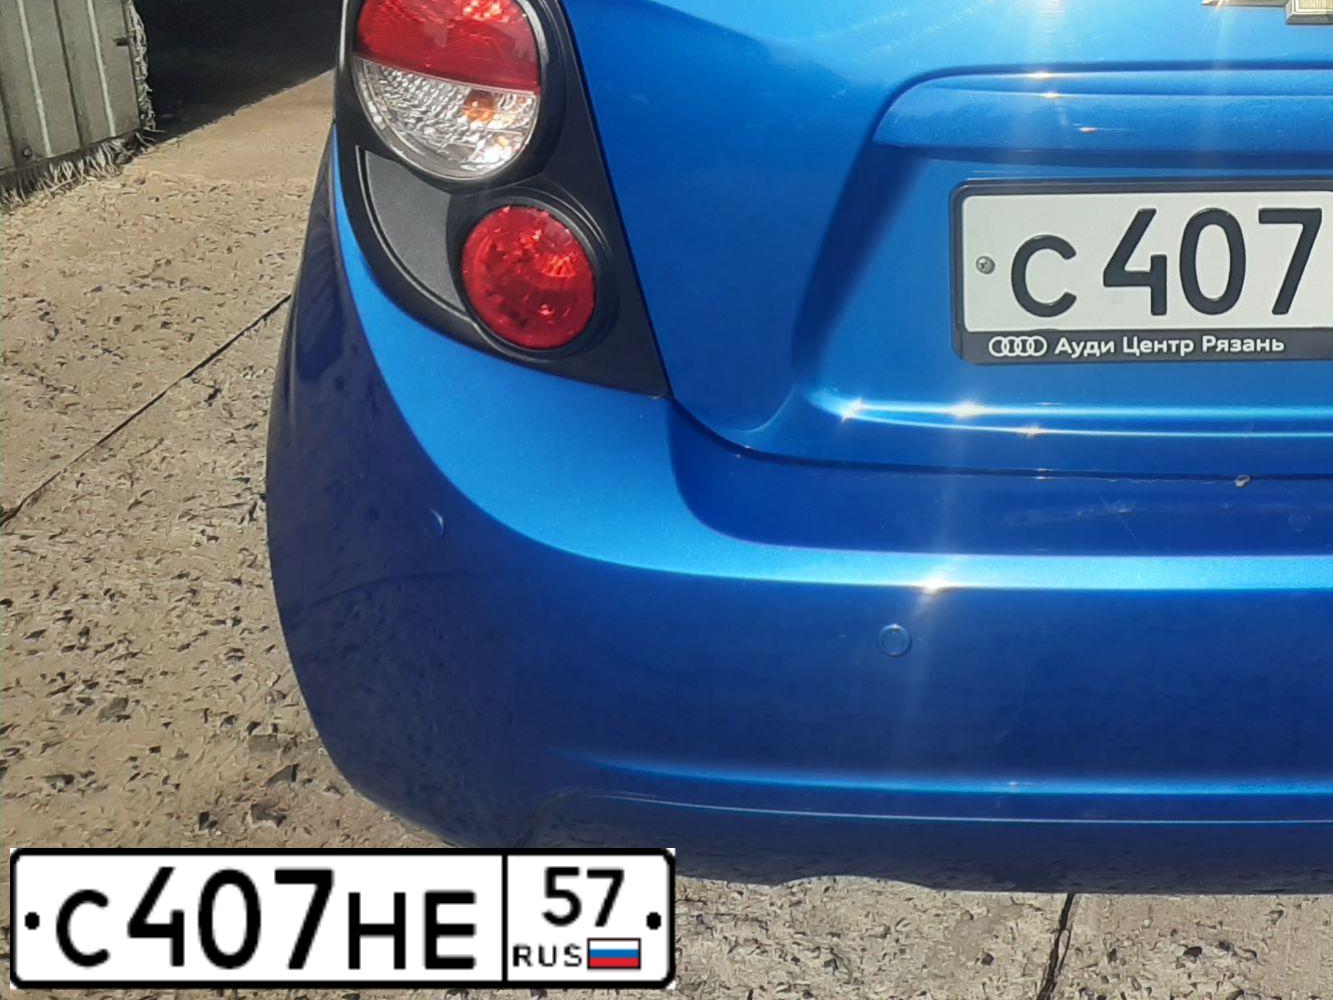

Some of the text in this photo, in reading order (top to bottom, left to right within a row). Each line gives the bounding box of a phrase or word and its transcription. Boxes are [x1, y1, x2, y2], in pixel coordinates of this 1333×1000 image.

[1054, 335, 1285, 358] Ауди Центр Рязань
